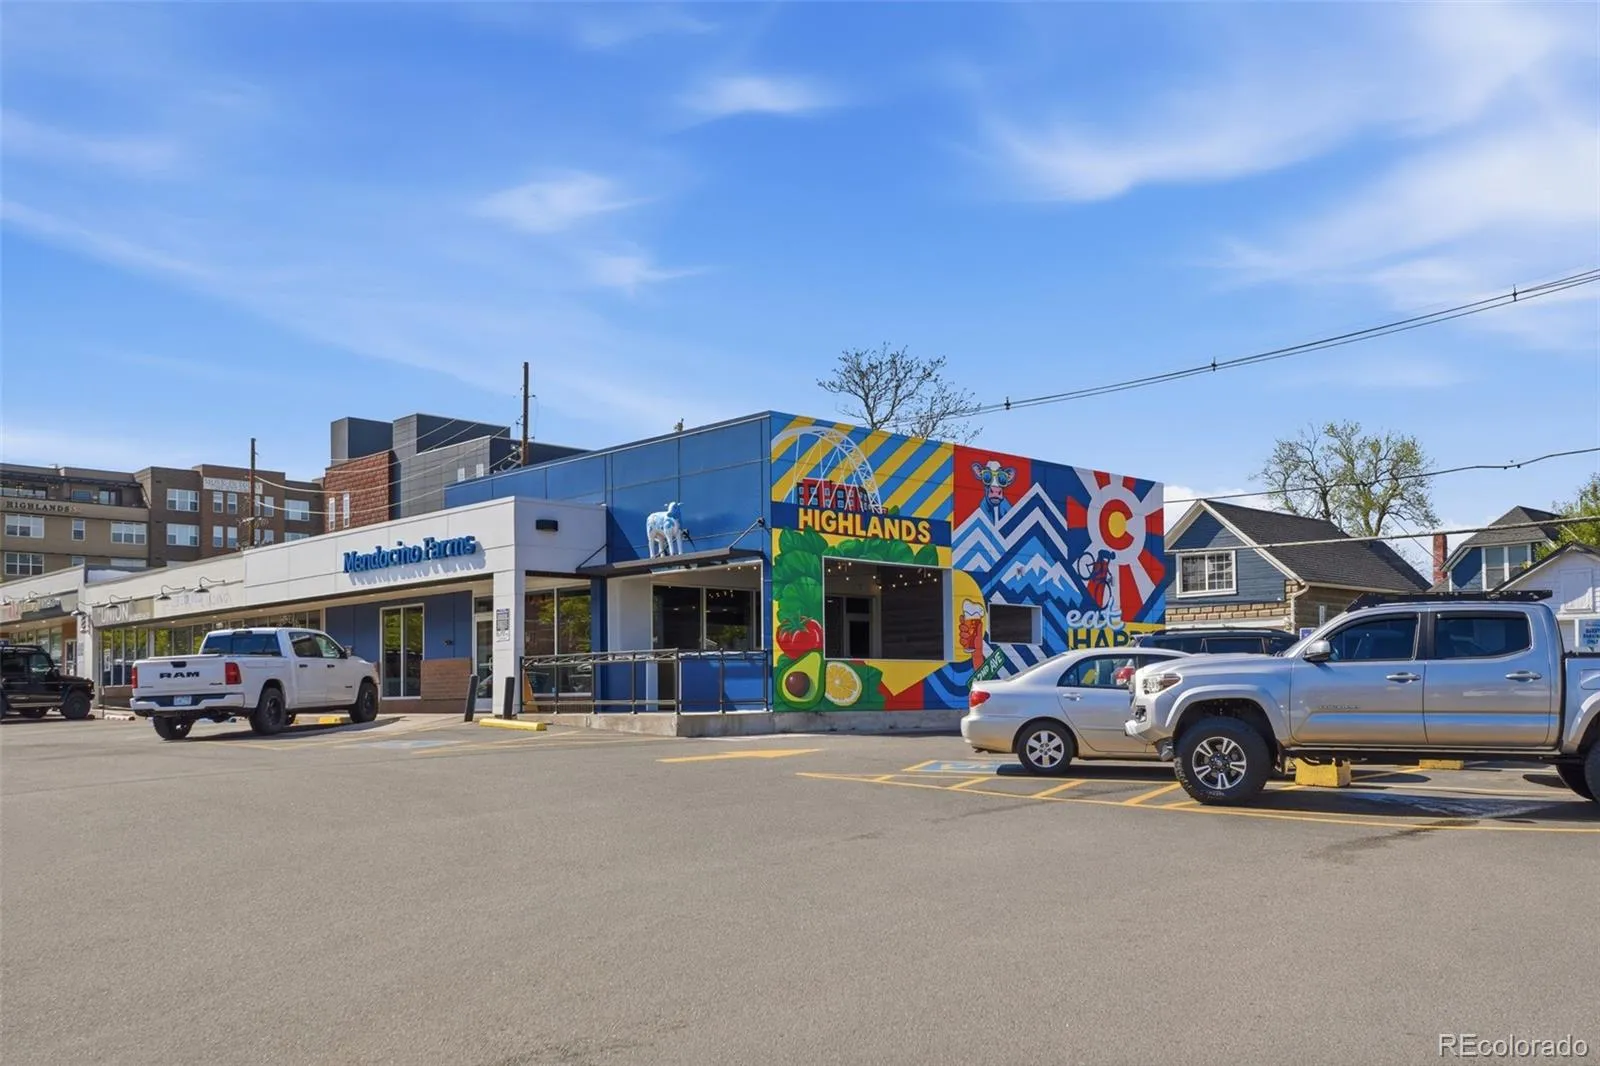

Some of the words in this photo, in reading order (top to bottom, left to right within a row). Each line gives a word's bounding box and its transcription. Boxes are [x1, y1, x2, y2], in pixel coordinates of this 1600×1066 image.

[798, 507, 932, 543] HIGHLANDS
[343, 541, 422, 573] Mendocino
[423, 536, 476, 561] Farms
[1066, 597, 1125, 630] eat
[159, 671, 200, 679] RAM
